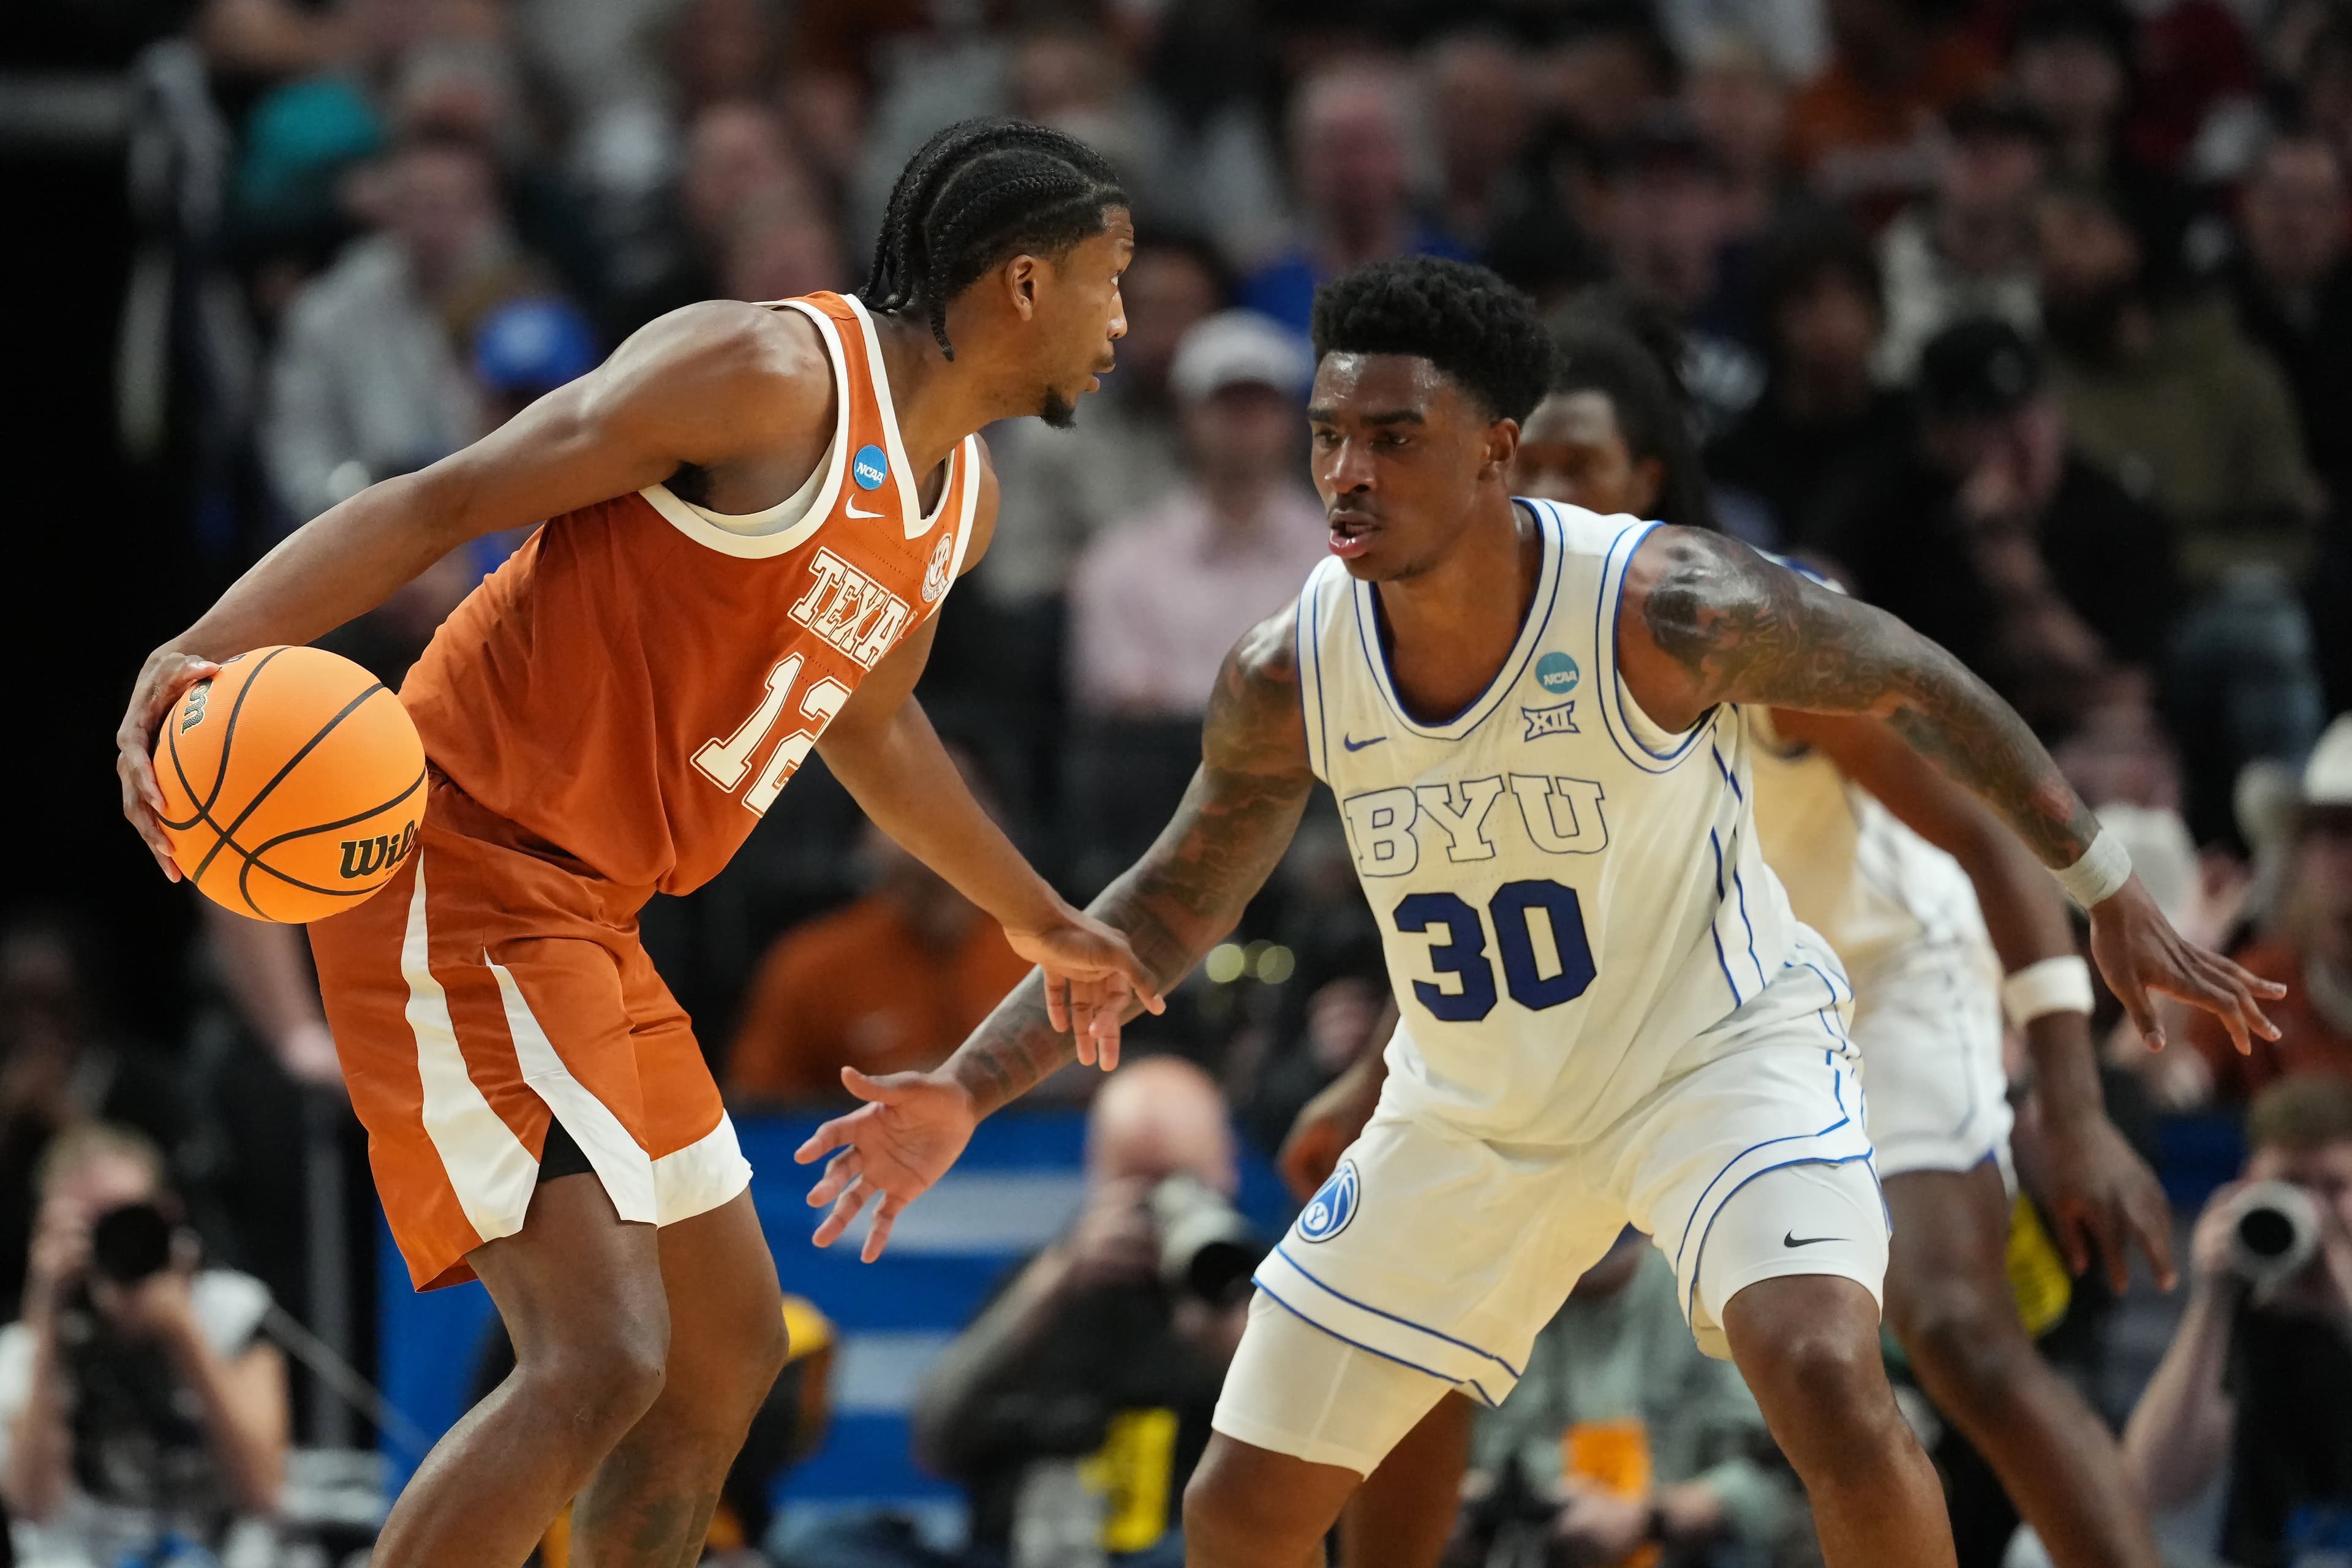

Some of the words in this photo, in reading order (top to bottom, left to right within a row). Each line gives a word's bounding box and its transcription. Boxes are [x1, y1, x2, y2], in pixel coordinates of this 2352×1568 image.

[856, 462, 884, 483] NCAA
[788, 546, 918, 671] TEXA
[690, 652, 852, 818] 12
[1544, 670, 1577, 685] NCAA
[1343, 772, 1608, 877] BYU
[1392, 879, 1597, 1022] 30
